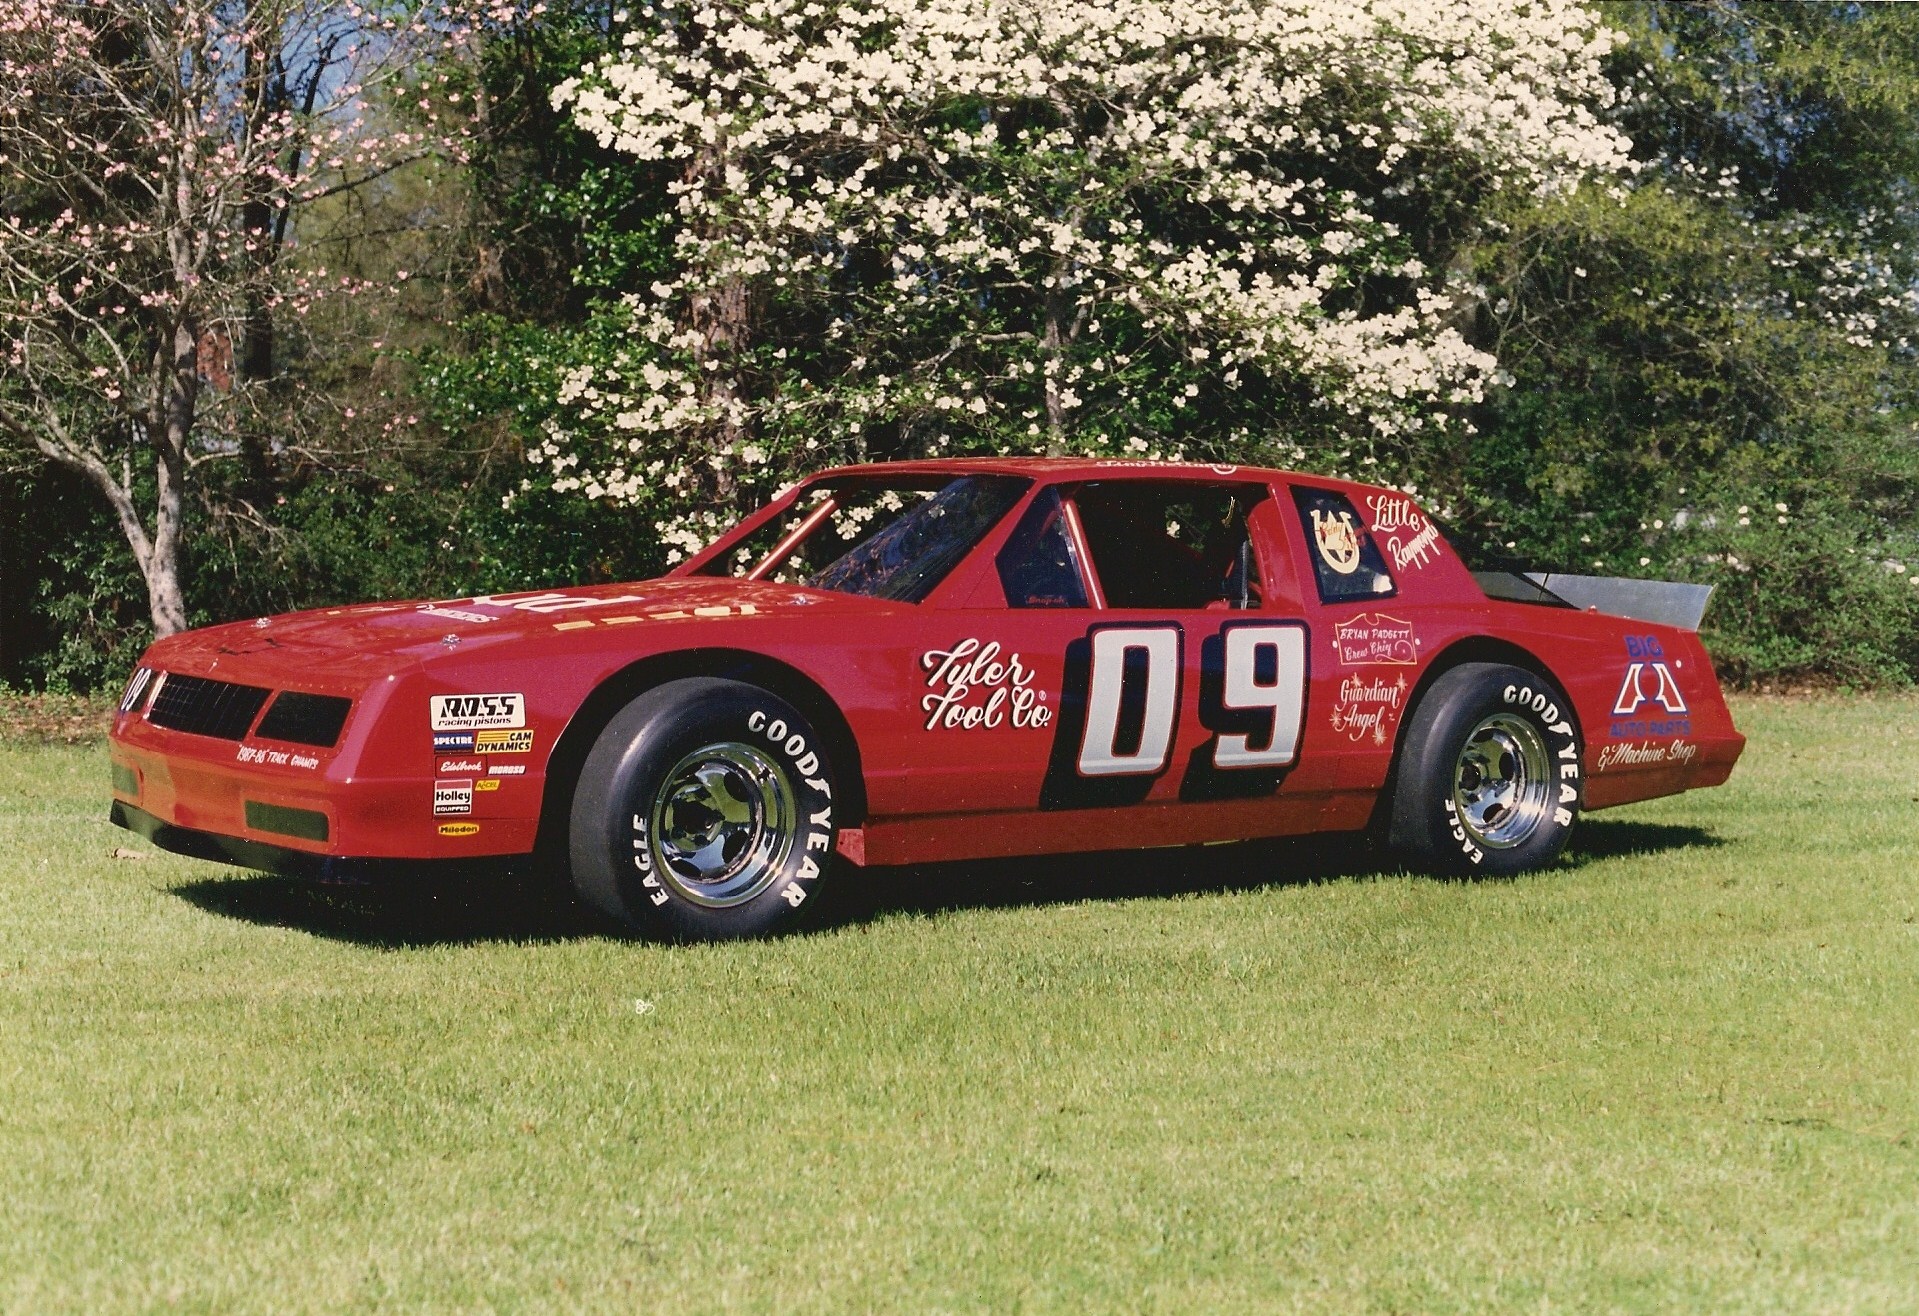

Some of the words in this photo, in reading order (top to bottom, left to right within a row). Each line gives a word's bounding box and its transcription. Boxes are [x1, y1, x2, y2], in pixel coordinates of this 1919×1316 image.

[1367, 495, 1420, 532] Little
[1340, 629, 1368, 640] BRYAN
[1372, 628, 1410, 640] PADGETT
[1624, 635, 1664, 658] BIG
[922, 637, 1036, 687] Tyler
[1344, 646, 1368, 662] Crew
[440, 695, 517, 718] ROSS
[1078, 627, 1305, 776] 09
[1335, 677, 1400, 711] Guardian
[921, 684, 1008, 731] Tool
[438, 718, 472, 727] racing
[474, 716, 512, 727] pistons
[1335, 704, 1385, 742] Angel
[1610, 722, 1646, 736] AUTO
[1649, 721, 1690, 735] PARTS
[433, 736, 474, 745] SPECTRE
[476, 742, 531, 752] DYNAMICS
[509, 732, 532, 741] CAM
[1502, 684, 1579, 828] GOODYEAR
[1666, 738, 1697, 765] Shop
[440, 761, 482, 772] Edelbrock
[436, 790, 471, 803] Holley
[748, 709, 832, 908] GOODYEAR
[1444, 798, 1484, 865] EAGLE
[632, 813, 670, 907] EAGLE
